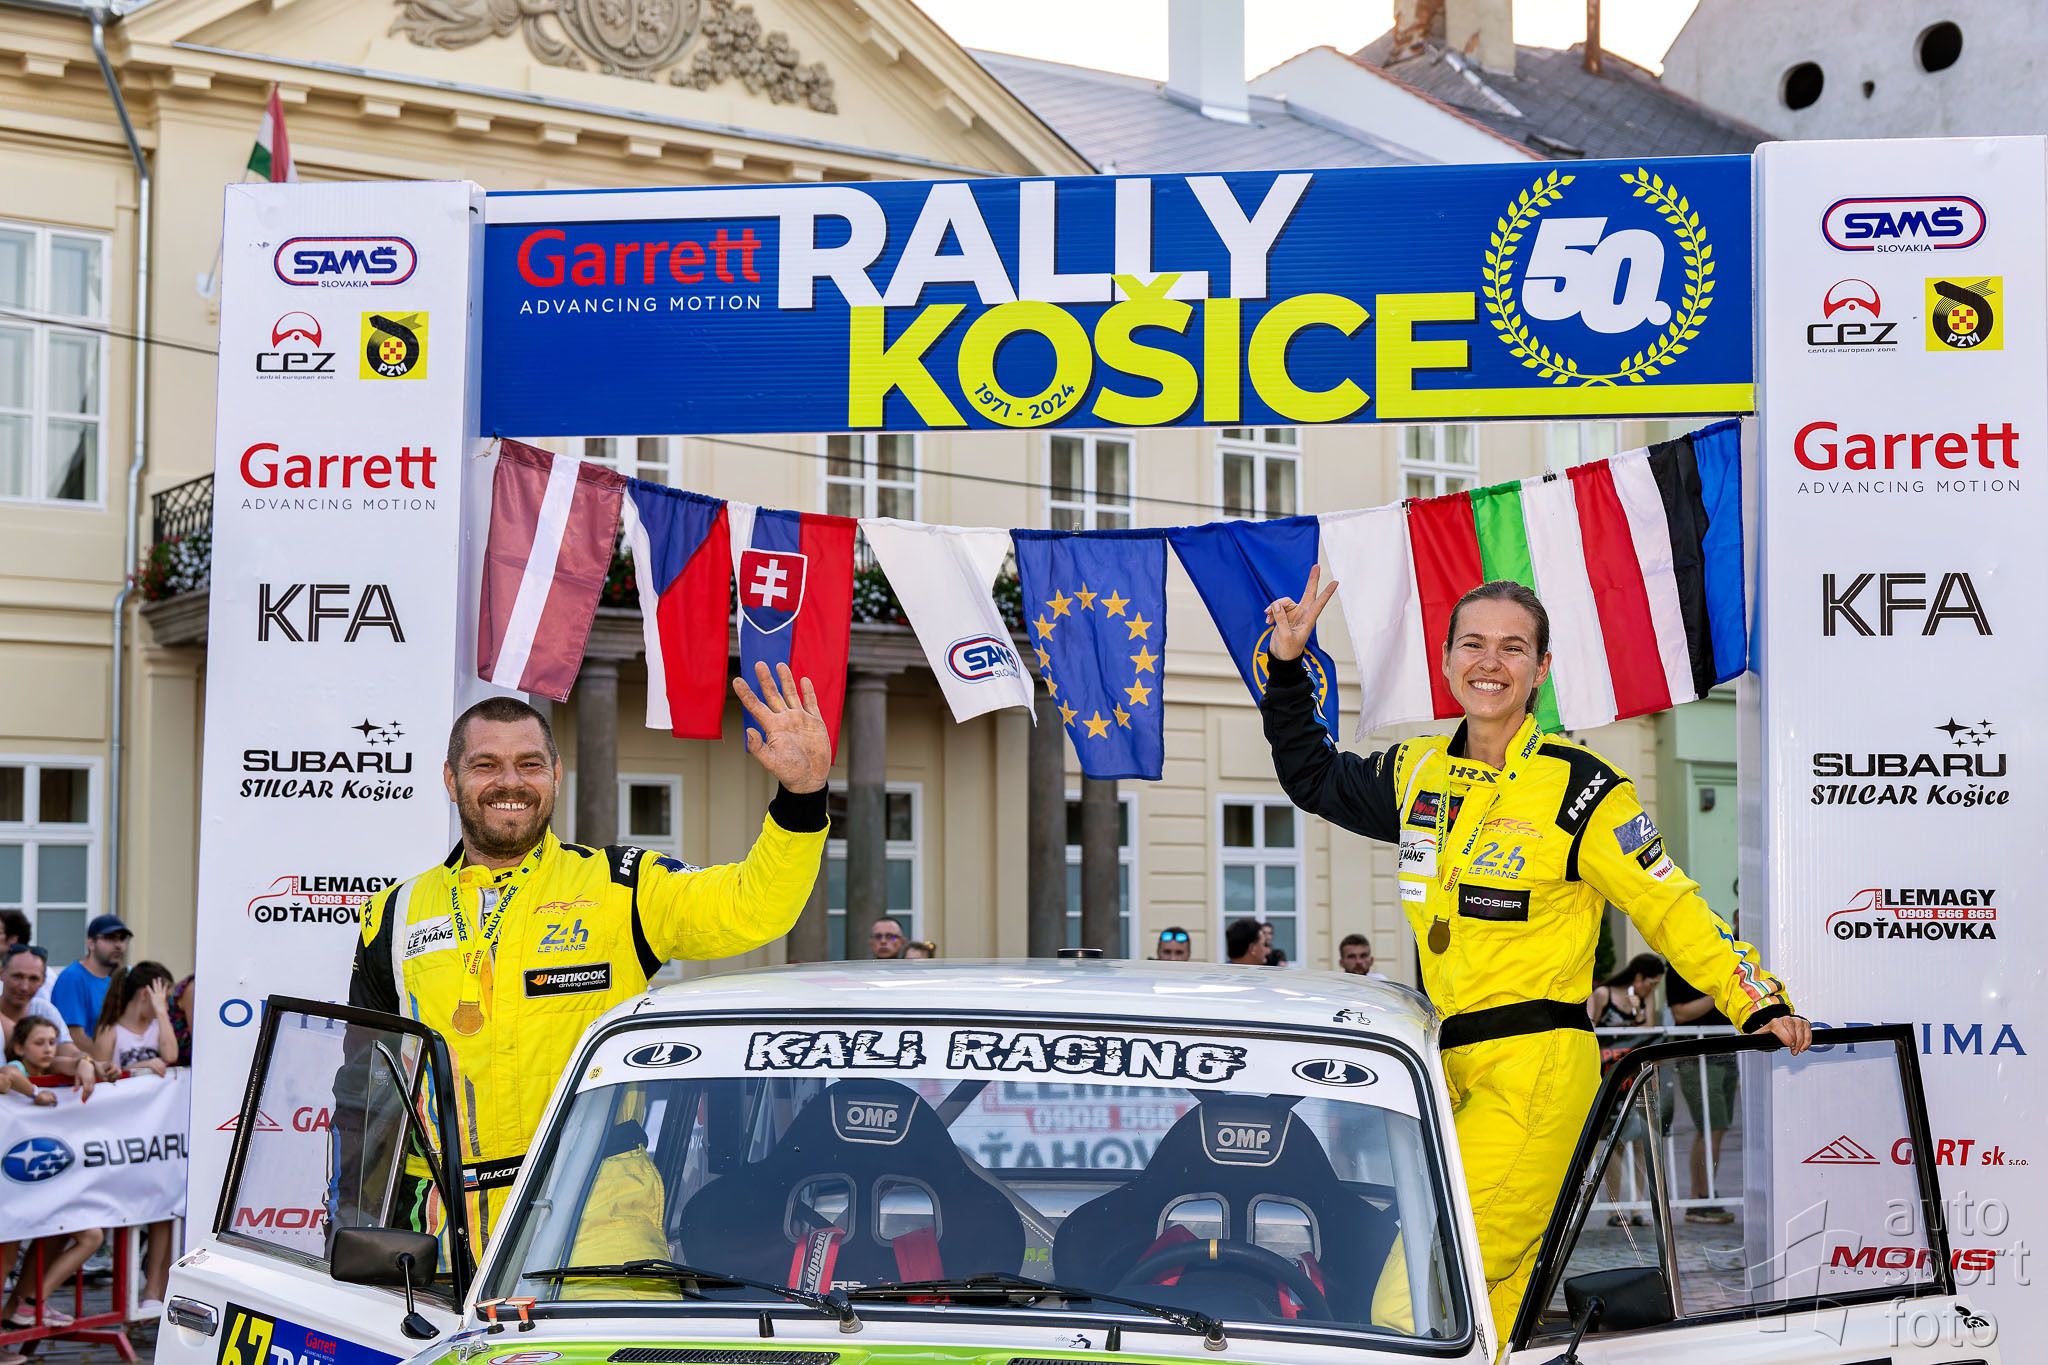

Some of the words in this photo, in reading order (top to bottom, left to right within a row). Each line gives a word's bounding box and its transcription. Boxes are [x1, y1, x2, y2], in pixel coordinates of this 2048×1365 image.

[1844, 206, 1964, 239] SAMŠ
[778, 173, 1314, 309] RALLY
[1877, 244, 1932, 253] SLOVAKIA
[293, 246, 398, 275] SAMŠ
[517, 229, 761, 287] Garrett
[321, 280, 369, 288] SLOVAKIA
[1521, 216, 1672, 334] 50.
[519, 296, 658, 315] ADVANCING
[670, 294, 761, 312] MOTION
[848, 273, 1477, 429] KOŠICE
[1946, 332, 1981, 347] PZM
[377, 362, 408, 376] PZM
[972, 382, 1011, 417] 1971
[1028, 382, 1076, 421] 2024
[1793, 421, 2020, 471] Garrett
[239, 442, 437, 489] Garrett
[1797, 480, 1925, 494] ADVANCING
[1937, 479, 2020, 492] MOTION
[241, 498, 352, 510] ADVANCING
[363, 498, 436, 511] MOTION
[257, 583, 406, 643] KFA
[1822, 572, 1994, 637] KFA
[242, 749, 413, 774] SUBARU
[1448, 764, 1502, 784] HRX
[1812, 752, 2007, 778] SUBARU
[239, 778, 334, 799] STILCAR
[341, 779, 414, 802] Košice
[1567, 770, 1608, 821] HRX
[1810, 783, 1919, 806] STILCAR
[1926, 783, 2010, 808] Košice
[1461, 826, 1479, 856] RALLY
[619, 847, 643, 877] HRX
[1468, 866, 1482, 875] LE
[1483, 868, 1519, 880] MANS
[300, 875, 398, 892] LEMAGY
[1443, 866, 1460, 892] Garrett
[311, 895, 341, 905] 0908
[450, 886, 460, 911] RALLY
[1464, 895, 1522, 909] HOOSIER
[1884, 888, 1997, 907] LEMAGY
[484, 913, 501, 940] RALLY
[497, 885, 519, 914] KOŠICE
[1898, 909, 1934, 919] 0908
[1937, 909, 1964, 919] 566
[1967, 909, 1995, 919] 865
[410, 928, 428, 940] ASIAN
[454, 911, 468, 941] KOŠICE
[1833, 917, 1997, 941] ODŤAHOVKA
[404, 945, 426, 958] SERIES
[407, 939, 420, 950] LE
[420, 929, 453, 946] MANS
[553, 943, 586, 952] MANS
[468, 950, 482, 975] Garrett
[744, 1030, 927, 1071] KALI
[946, 1030, 1249, 1083] RACING
[845, 1106, 899, 1128] OMP
[1217, 1127, 1272, 1150] OMP
[1890, 1137, 1976, 1166] GRT
[1981, 1145, 2006, 1166] sk
[2008, 1158, 2029, 1166] s.r.o.
[305, 1331, 337, 1356] Garrett
